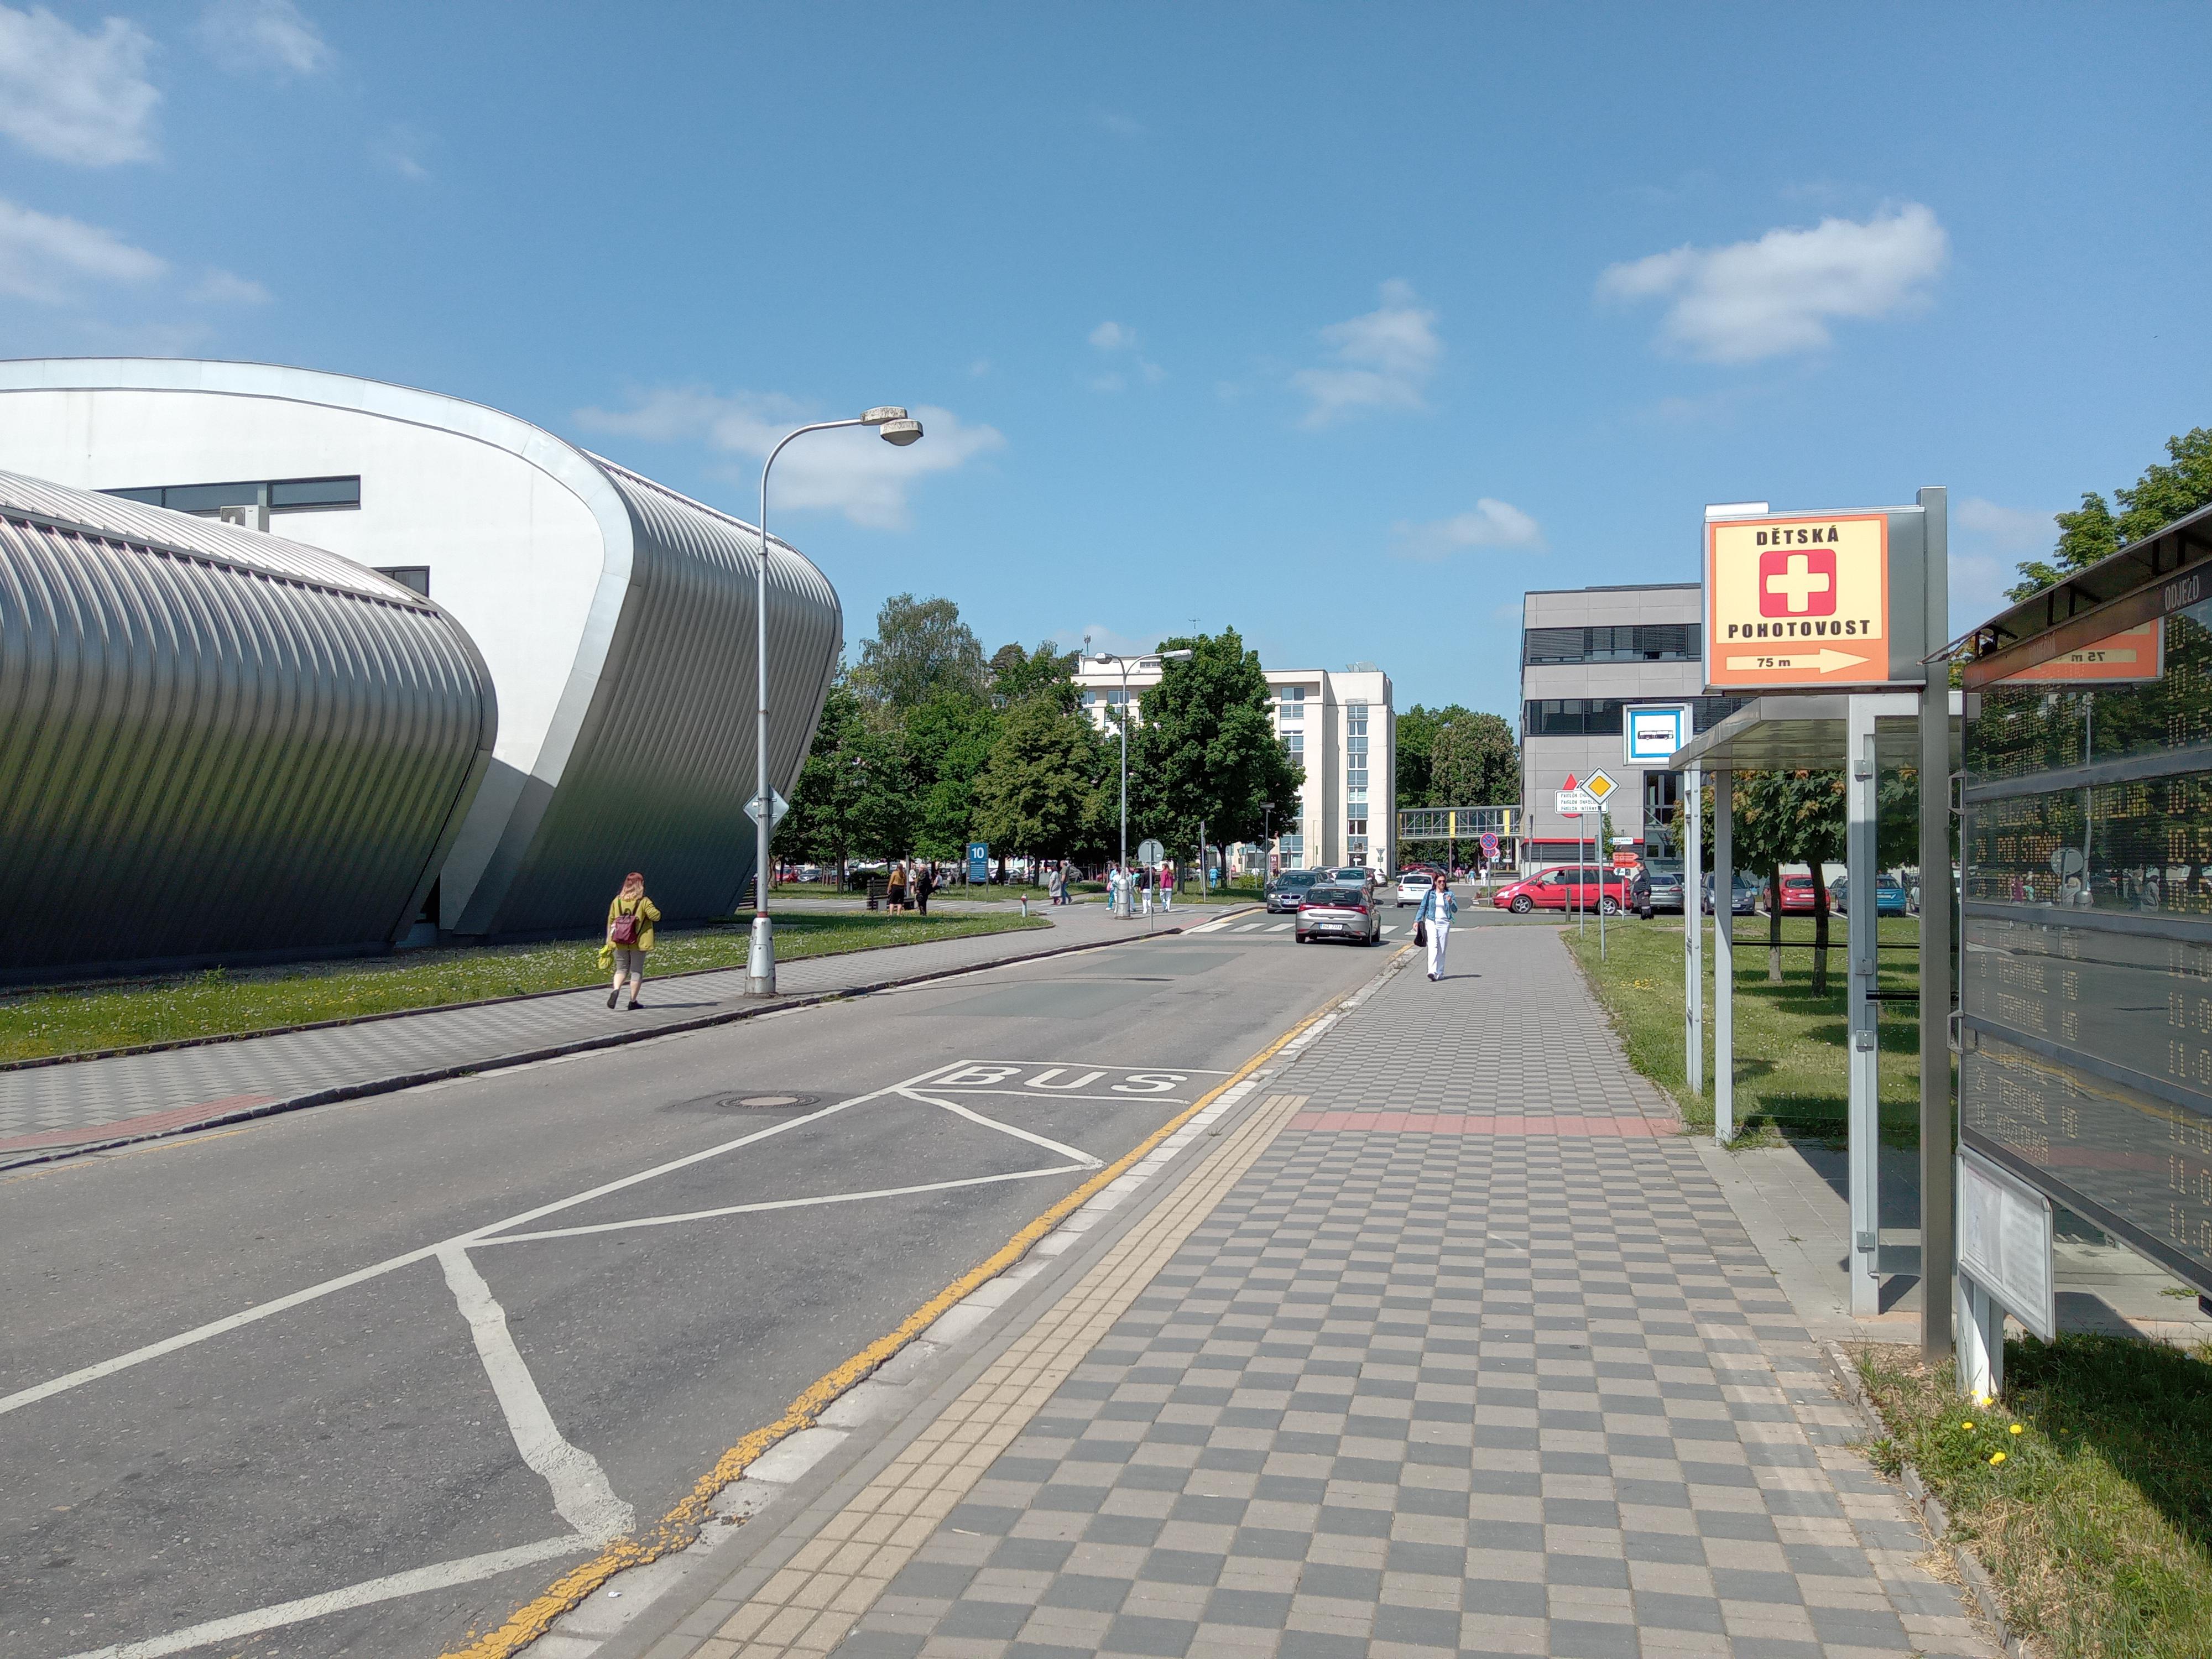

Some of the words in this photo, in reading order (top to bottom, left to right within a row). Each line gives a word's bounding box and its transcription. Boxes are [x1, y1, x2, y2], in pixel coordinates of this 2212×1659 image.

[1756, 525, 1839, 546] DĚTSKÁ
[1728, 619, 1871, 639] POHOTOVOST
[2167, 603, 2212, 653] 10:5
[1757, 658, 1773, 667] 75
[2167, 655, 2212, 701] 10:5
[2167, 705, 2212, 749] 10:5
[2167, 775, 2212, 814] 10:5
[971, 847, 984, 859] 10
[1997, 836, 2015, 863] POD
[2167, 827, 2212, 862] 10:5
[2167, 878, 2212, 914] 10:5
[2168, 945, 2212, 983] 11:0
[1997, 953, 2048, 994] TERMINÁL
[2062, 969, 2078, 1001] HD
[2168, 990, 2212, 1035] 11:0
[1996, 989, 2048, 1032] TERMINÁL
[2062, 1009, 2078, 1042] HD
[2168, 1039, 2212, 1087] 11:0
[929, 1066, 1188, 1092] BUS
[1997, 1071, 2048, 1125] TERMINÁL
[2060, 1103, 2079, 1141] HD
[2168, 1152, 2212, 1208] 11:0
[2168, 1105, 2212, 1156] 11:0
[2168, 1201, 2212, 1260] 11:0
